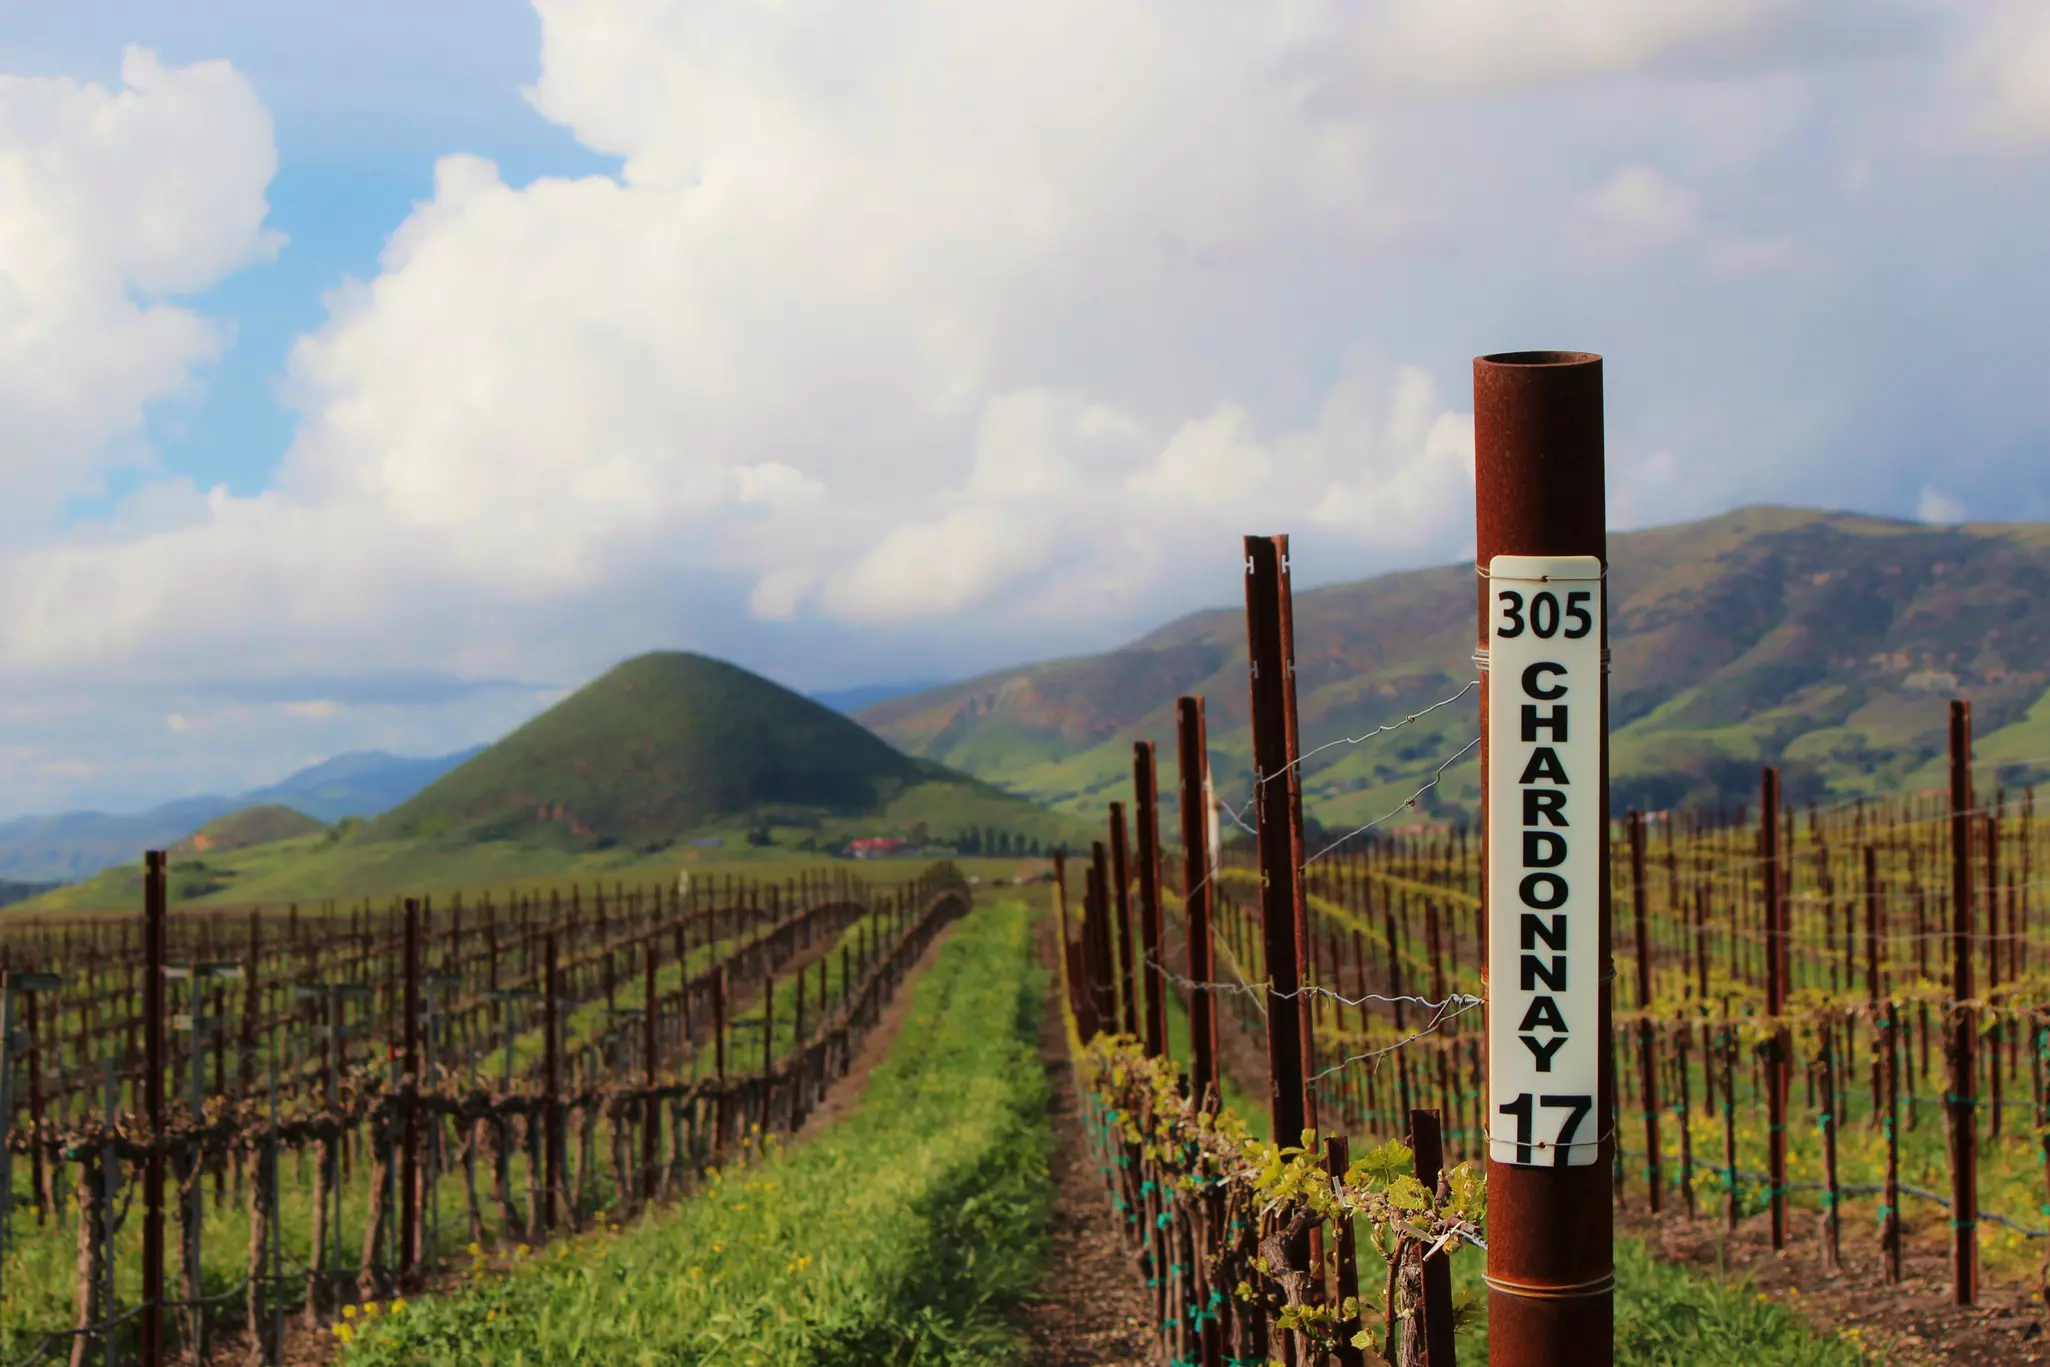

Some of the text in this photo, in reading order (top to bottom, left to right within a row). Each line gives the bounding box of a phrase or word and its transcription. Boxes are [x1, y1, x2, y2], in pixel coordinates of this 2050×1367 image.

[1497, 591, 1592, 639] 305
[1518, 661, 1570, 1072] CHARDONNAY
[1499, 1093, 1592, 1166] 17
